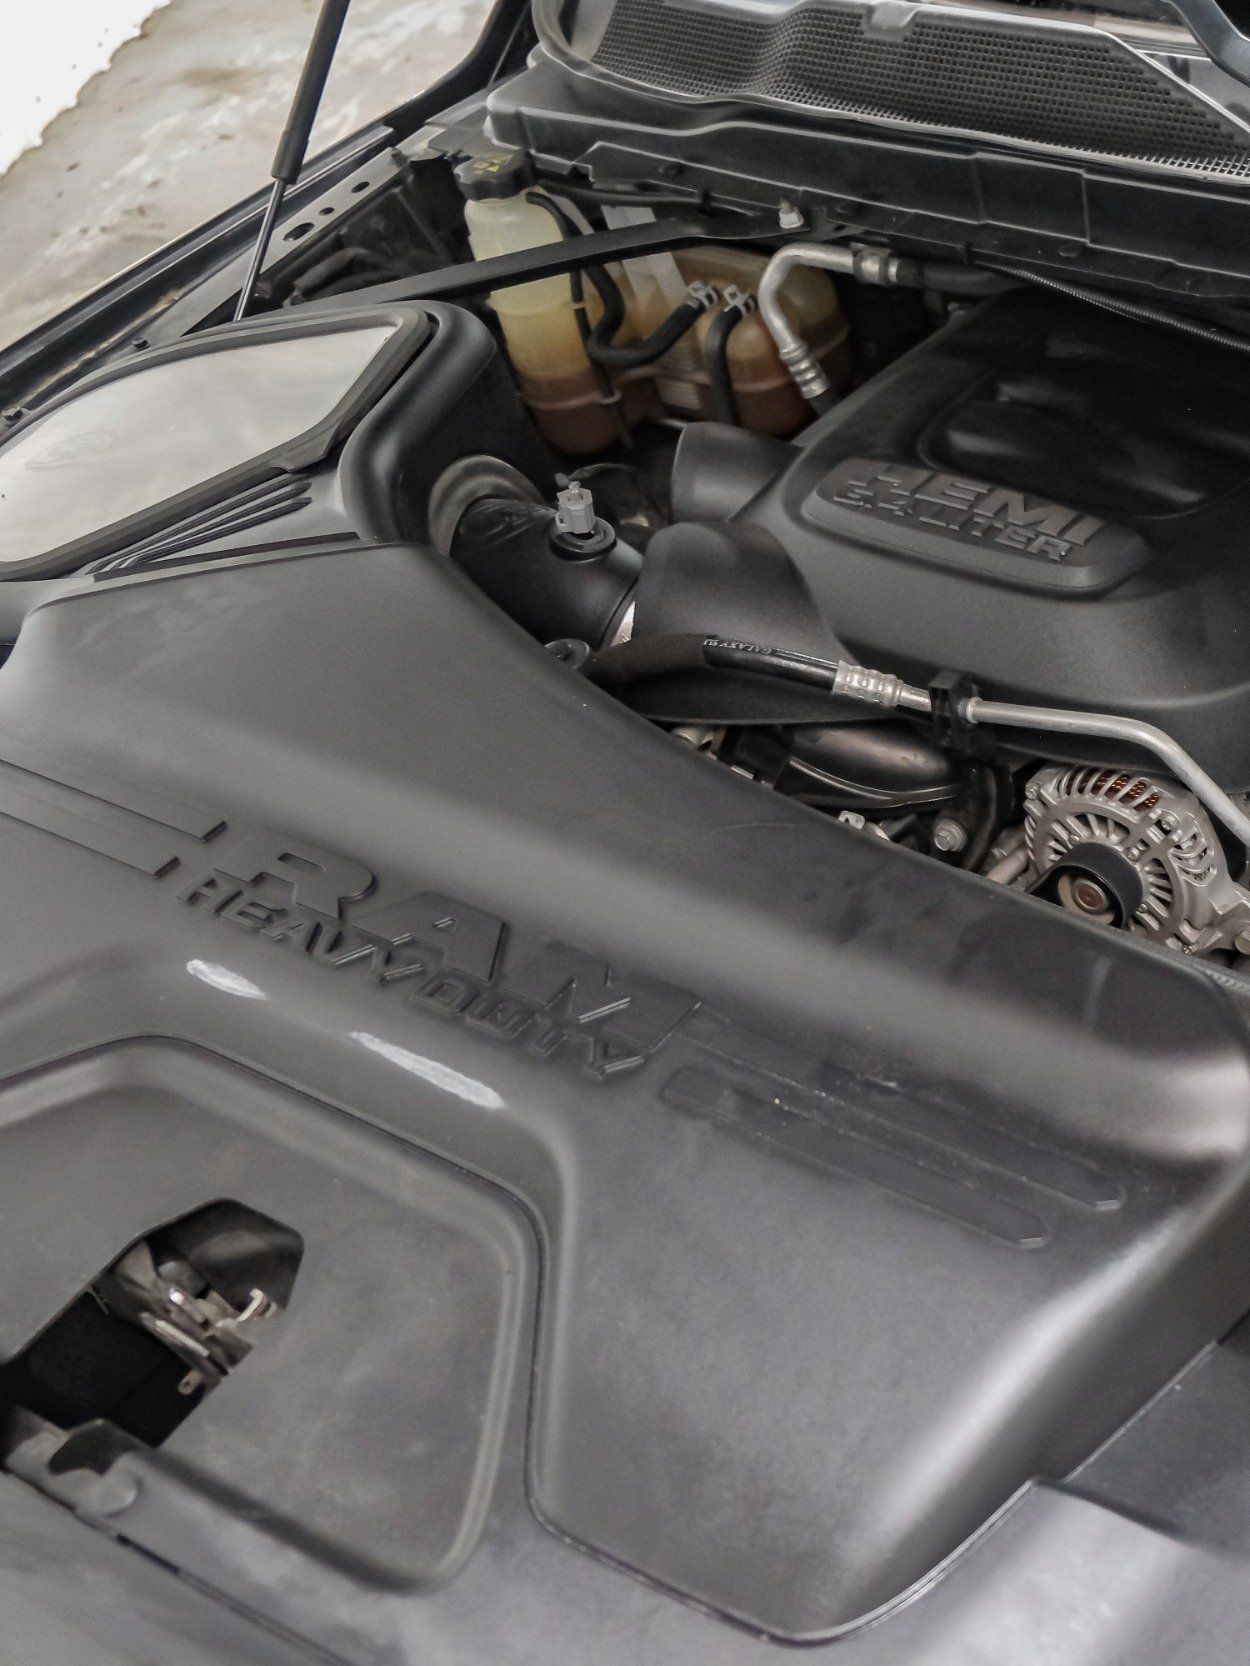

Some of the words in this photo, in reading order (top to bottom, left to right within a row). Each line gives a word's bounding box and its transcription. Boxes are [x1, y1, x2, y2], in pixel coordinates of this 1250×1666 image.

[176, 867, 424, 985] HEAVY
[410, 972, 646, 1080] DUTY
[213, 816, 701, 1054] RAM
